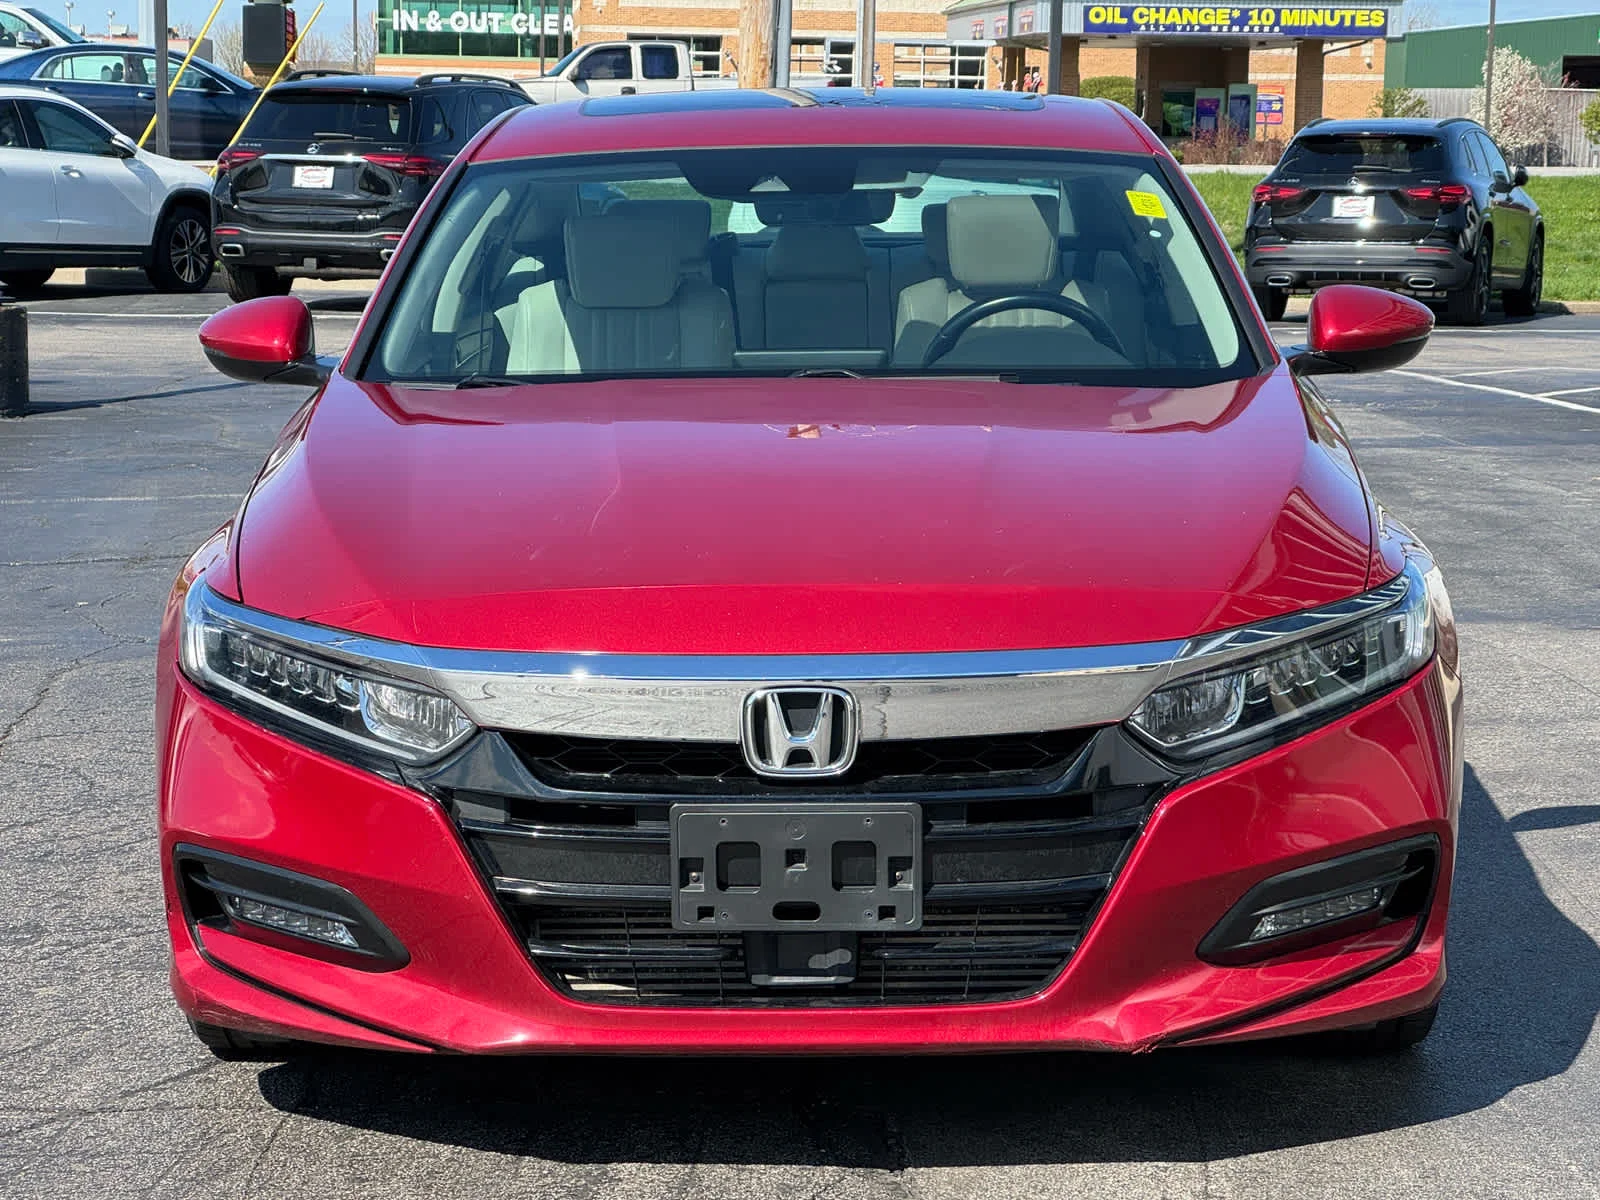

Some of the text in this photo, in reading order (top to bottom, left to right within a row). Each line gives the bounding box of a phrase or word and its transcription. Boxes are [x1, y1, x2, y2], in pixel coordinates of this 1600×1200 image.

[392, 9, 419, 31] IN
[425, 9, 442, 32] &
[449, 10, 504, 33] OUT
[1088, 6, 1128, 25] OIL
[1248, 8, 1275, 26] 10
[1280, 9, 1385, 27] MINUTES
[1176, 24, 1201, 32] VIP
